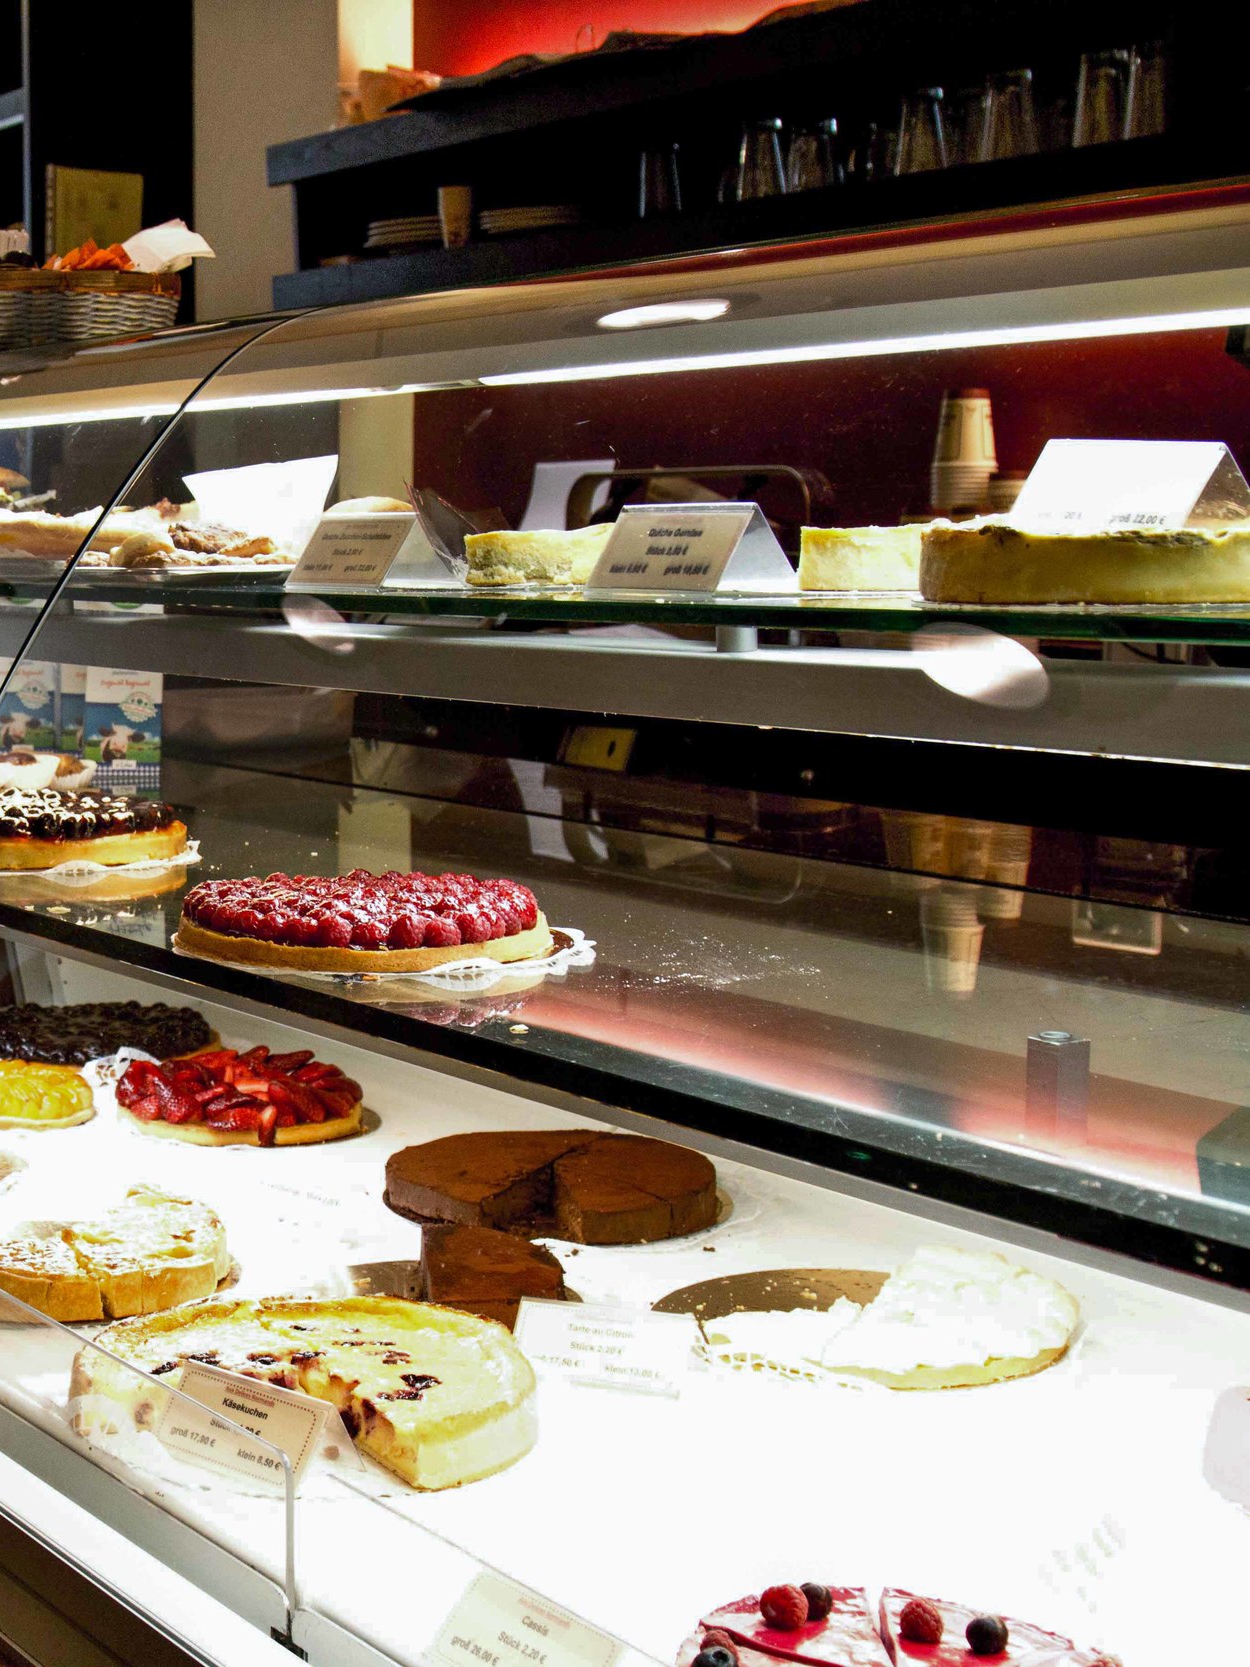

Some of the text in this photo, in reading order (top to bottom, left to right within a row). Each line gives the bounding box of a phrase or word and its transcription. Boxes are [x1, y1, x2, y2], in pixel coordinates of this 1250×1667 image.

[1134, 512, 1158, 525] 22,00
[1158, 516, 1166, 526] €
[568, 1323, 634, 1339] Tarte au Citron
[571, 1341, 595, 1352] Stück
[617, 1348, 624, 1356] €
[606, 1365, 628, 1376] klein
[223, 1398, 269, 1420] Käsekuchen
[170, 1426, 188, 1438] groß
[210, 1439, 217, 1448] €
[237, 1449, 282, 1472] klein 8,50 €
[522, 1615, 550, 1638] Cassis
[451, 1635, 472, 1651] groß
[492, 1656, 501, 1667] €
[498, 1631, 549, 1666] Stück 2,20 €
